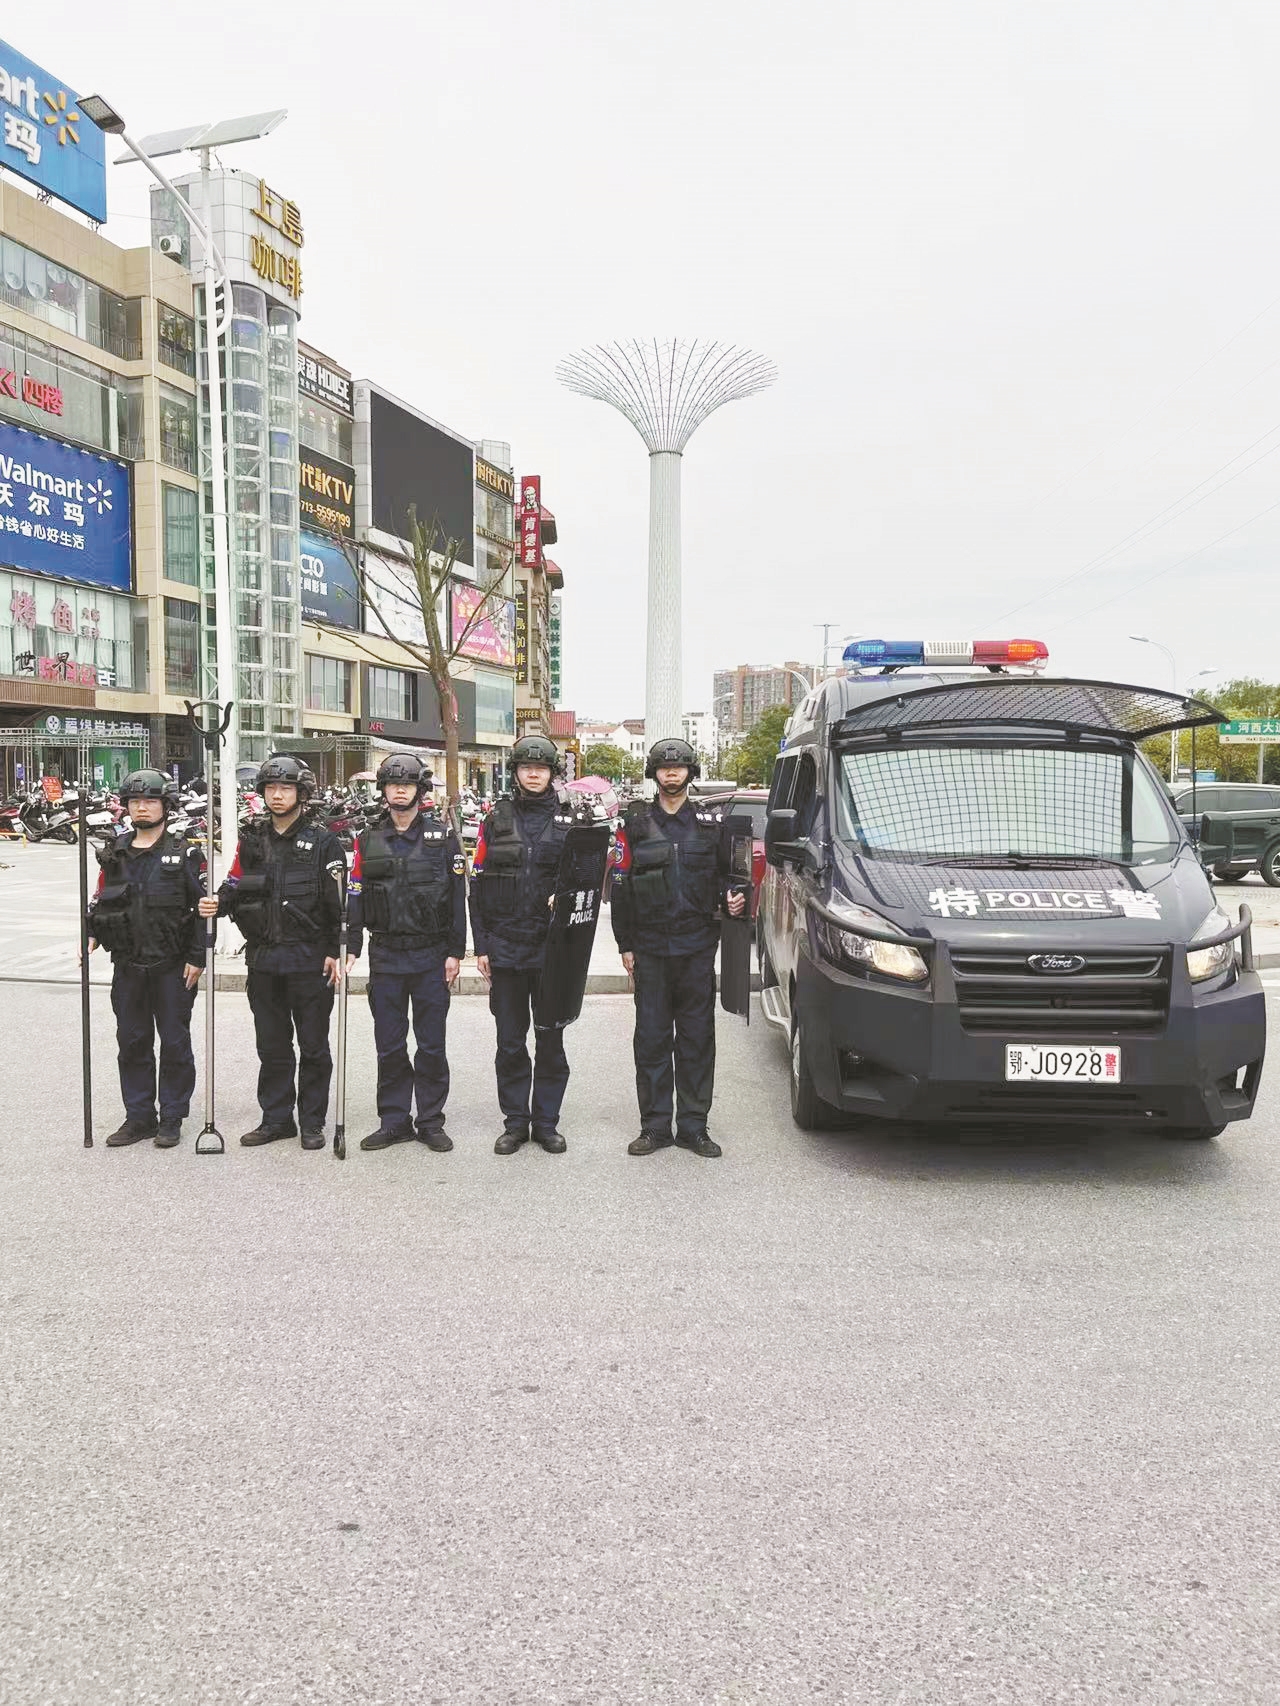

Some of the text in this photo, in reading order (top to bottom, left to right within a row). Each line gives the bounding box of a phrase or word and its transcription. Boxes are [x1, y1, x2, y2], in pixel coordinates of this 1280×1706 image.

[5, 111, 41, 165] 玛
[249, 233, 304, 300] 咖啡
[0, 454, 84, 502] Walmart
[524, 516, 537, 563] 肯德基
[516, 710, 540, 719] COFFEE
[569, 909, 593, 925] POLICE
[928, 887, 1162, 920] 特 POLICE 警
[1041, 955, 1073, 968] Ford
